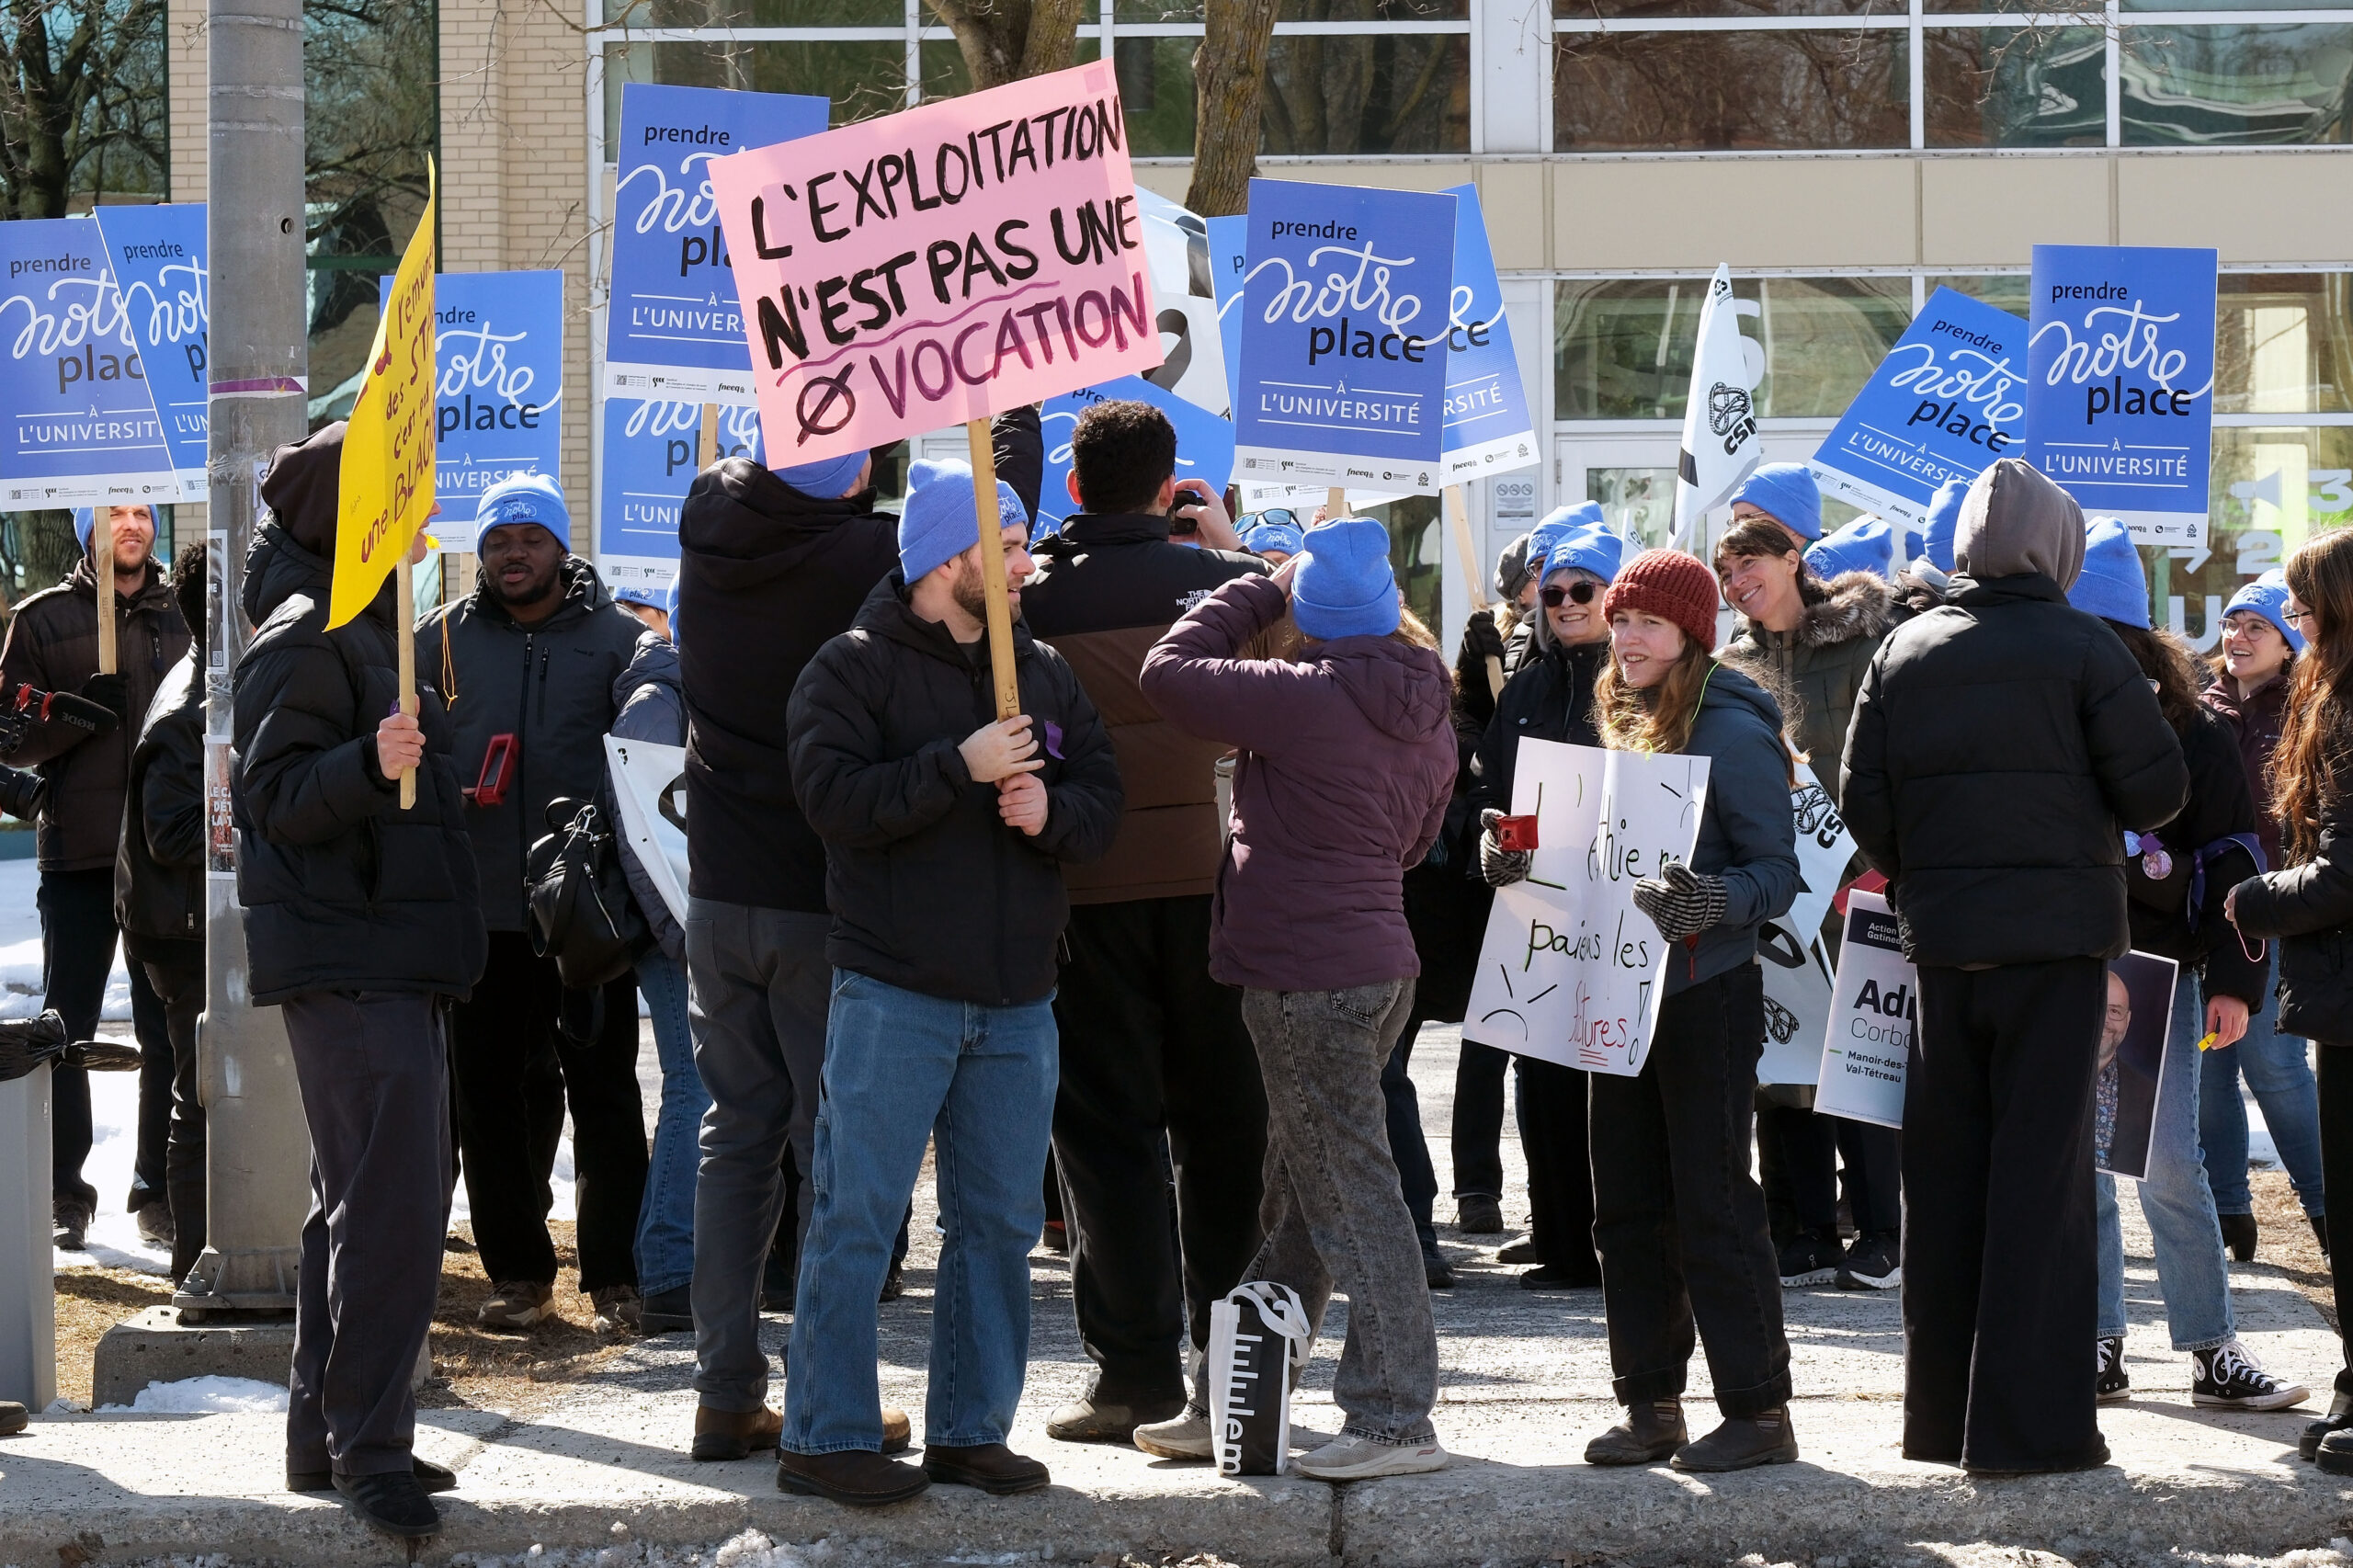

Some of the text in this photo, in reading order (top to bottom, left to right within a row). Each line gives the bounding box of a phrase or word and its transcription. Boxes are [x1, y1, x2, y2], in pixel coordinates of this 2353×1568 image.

[644, 124, 731, 146] prendre
[750, 95, 1120, 260] L'EXPLOITATION
[1271, 219, 1358, 241] prendre
[10, 253, 91, 278] prendre
[123, 240, 184, 264] prendre
[756, 250, 916, 369] N'EST
[926, 219, 1040, 304] PAS
[1050, 194, 1140, 266] UNE
[1244, 241, 1449, 347] notre
[2052, 281, 2128, 303] prendre
[708, 291, 718, 307] À
[870, 271, 1147, 420] VOCATION
[1309, 317, 1426, 366] place
[1931, 316, 2003, 355] prendre
[2029, 299, 2213, 400] notre
[58, 344, 143, 394] plac
[386, 381, 404, 421] des
[1336, 380, 1347, 395] À
[1890, 343, 2028, 443] notre
[2086, 376, 2191, 424] place
[88, 404, 99, 418] À
[438, 394, 540, 443] place
[1261, 393, 1420, 425] L'UNIVERSITÉ
[1907, 397, 2011, 452] place
[463, 452, 472, 467] À
[2112, 437, 2121, 451] À
[2045, 454, 2188, 477] L'UNIVERSITÉ
[360, 508, 388, 563] une
[1188, 589, 1204, 598] THE
[61, 711, 97, 732] RØDE
[1613, 909, 1649, 969] les
[1869, 922, 1897, 935] Action
[1846, 1063, 1902, 1084] Val-Tétreau
